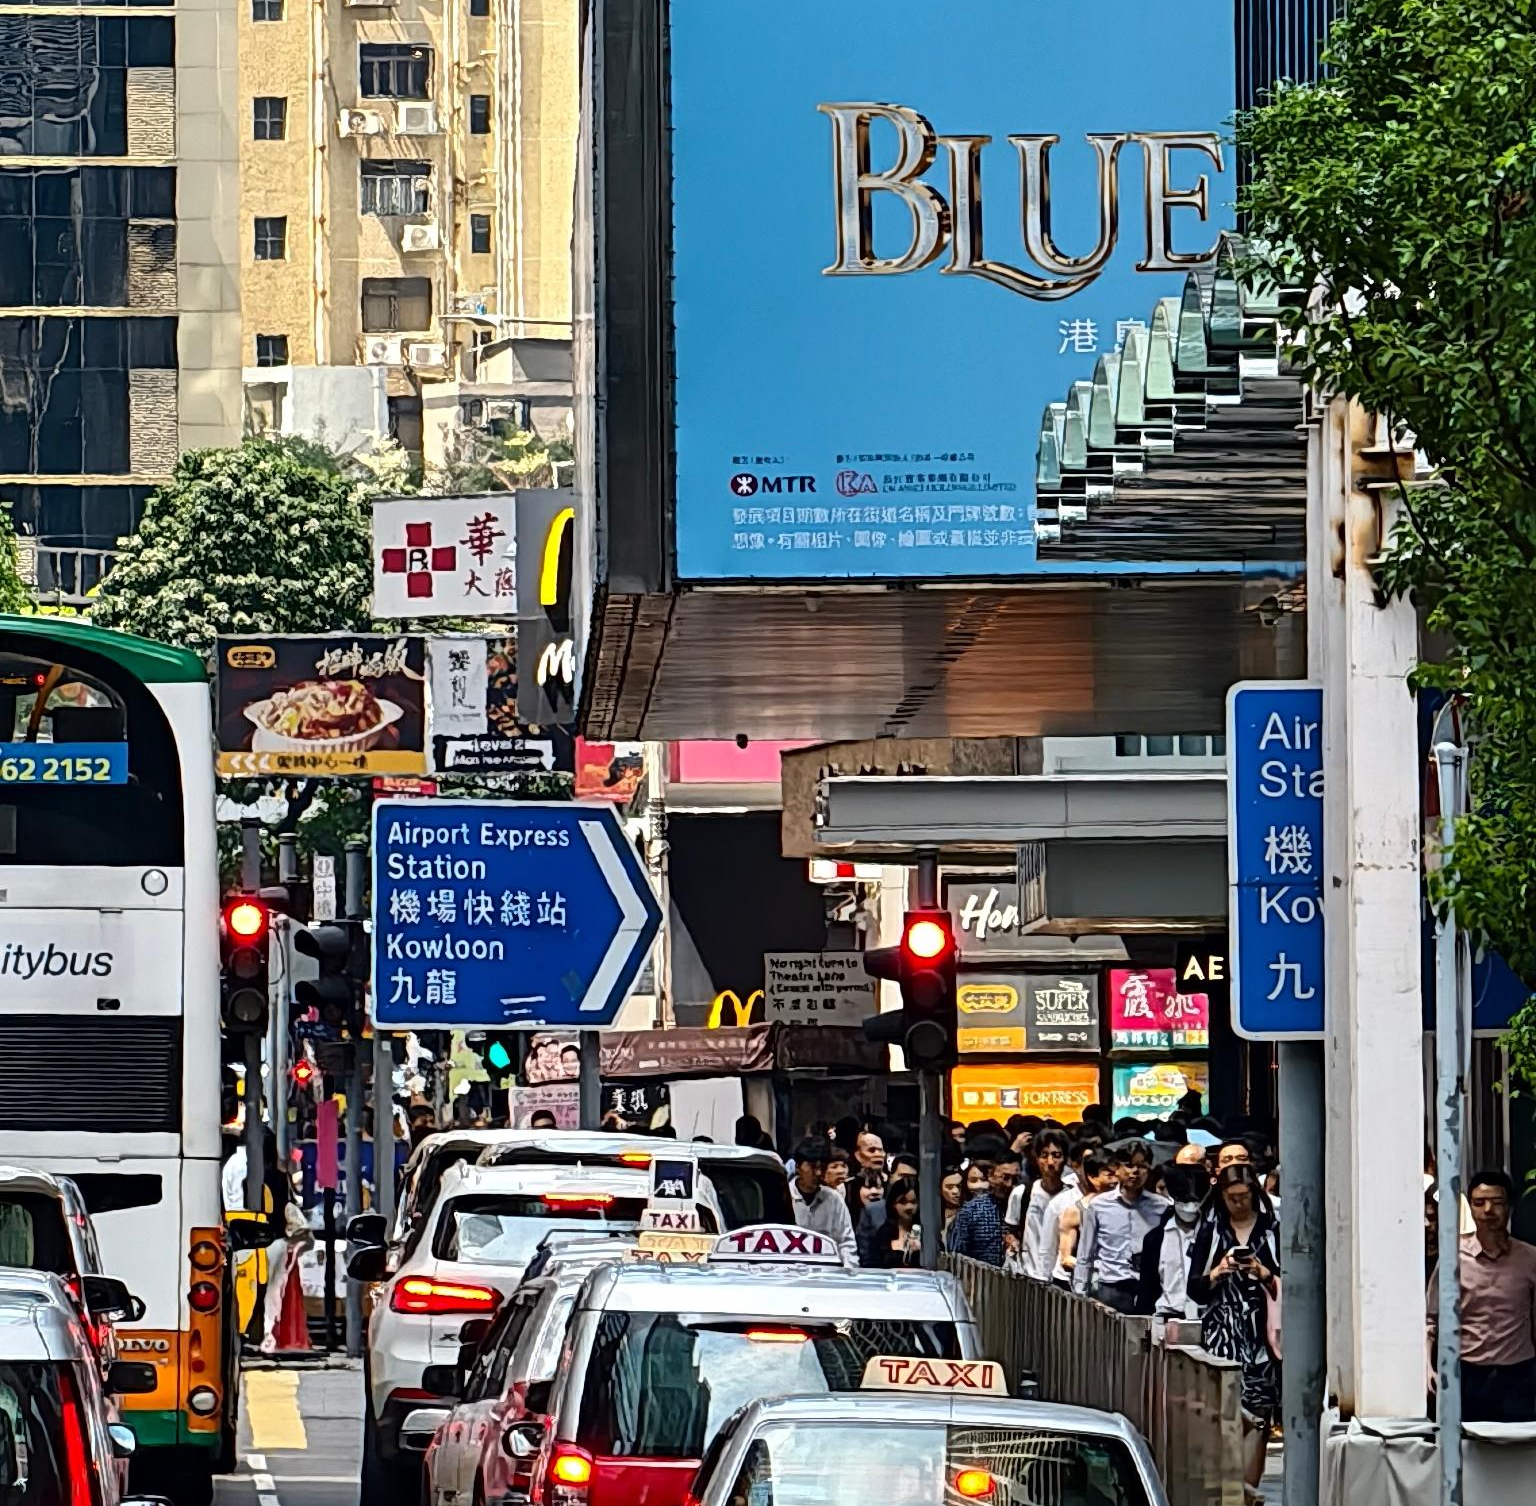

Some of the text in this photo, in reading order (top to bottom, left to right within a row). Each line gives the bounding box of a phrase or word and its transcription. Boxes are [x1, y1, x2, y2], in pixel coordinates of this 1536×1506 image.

[761, 476, 817, 494] MTR
[538, 639, 575, 685] M
[42, 758, 112, 782] 2152
[387, 822, 570, 851] Airport Express
[387, 854, 486, 880] Station
[390, 888, 567, 927] 機場快綫站
[386, 932, 504, 960] Kowloon
[389, 967, 457, 1005] 九龍
[1034, 989, 1090, 1011] SUPER
[1023, 1090, 1090, 1106] FORTRESS
[648, 1212, 696, 1229] TAXI
[730, 1229, 823, 1255] TAXI
[631, 1249, 705, 1263] TAX
[879, 1358, 994, 1389] TAXI
